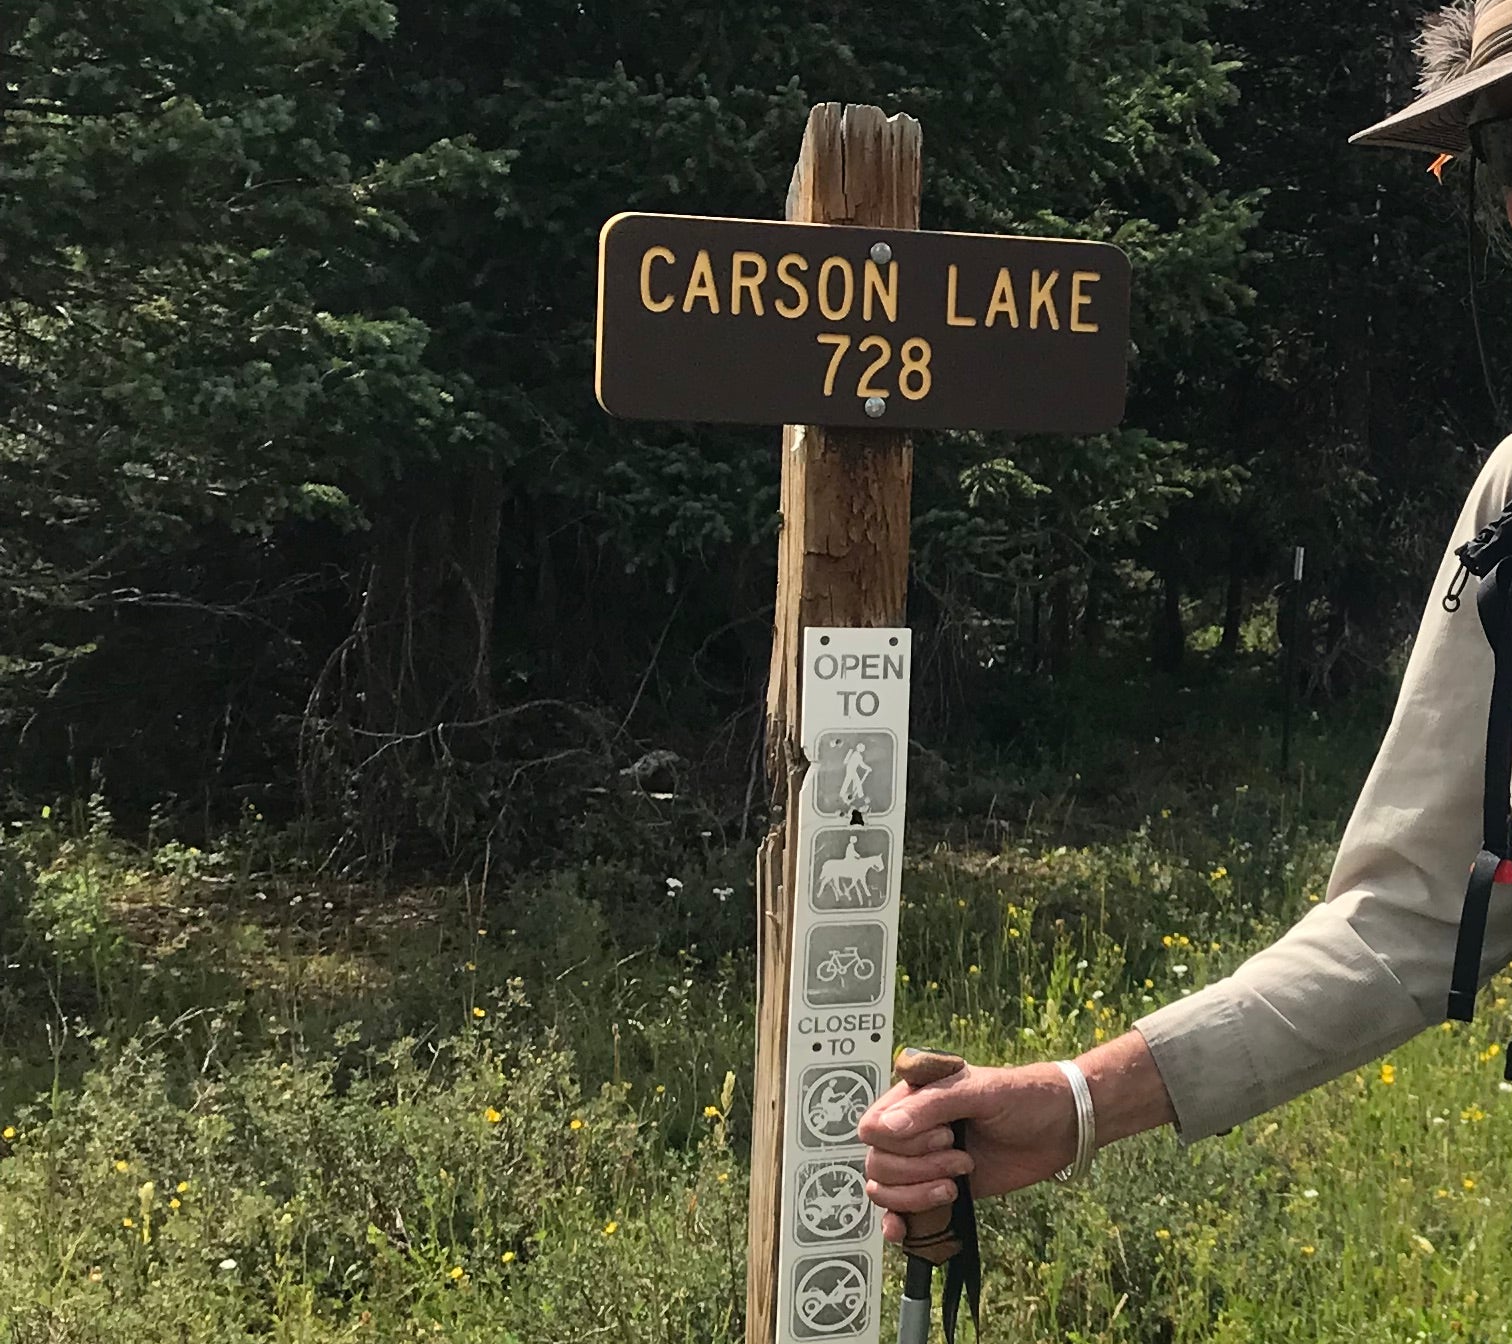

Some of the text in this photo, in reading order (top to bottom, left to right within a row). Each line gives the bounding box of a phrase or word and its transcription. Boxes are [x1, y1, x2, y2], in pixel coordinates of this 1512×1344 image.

[640, 246, 1101, 333] CARSON LAKE
[817, 333, 932, 400] 728
[814, 654, 904, 681] OPEN
[837, 690, 880, 717] TO
[798, 1013, 886, 1034] CLOSED
[827, 1038, 855, 1056] TO
